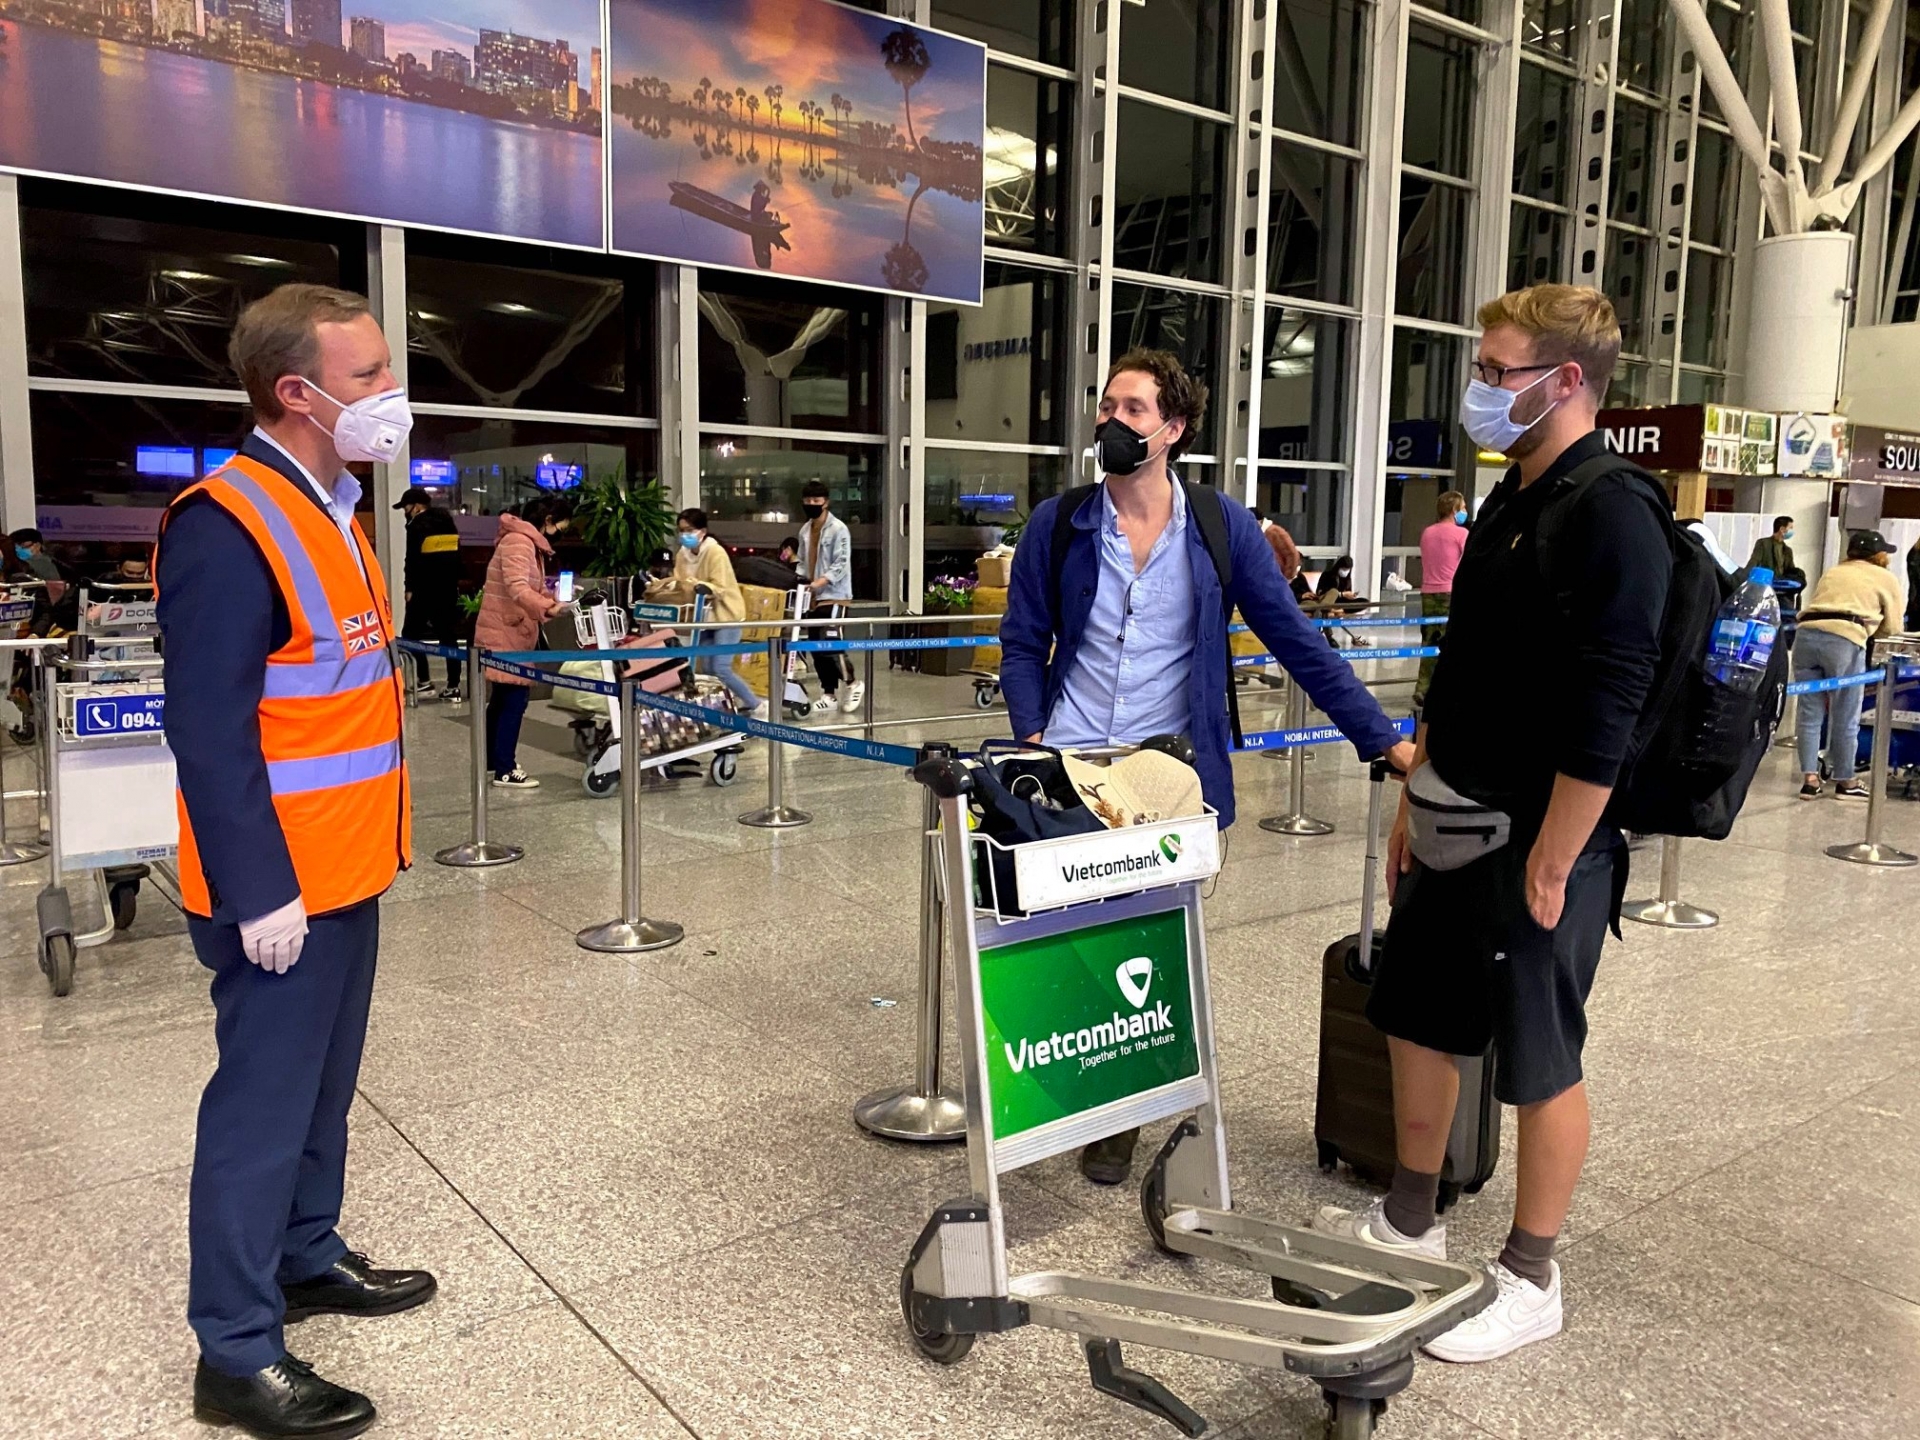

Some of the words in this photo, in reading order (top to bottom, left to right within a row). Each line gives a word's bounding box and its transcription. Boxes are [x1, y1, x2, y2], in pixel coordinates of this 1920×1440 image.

[1886, 445, 1920, 471] SOU
[122, 712, 162, 728] 094.
[1245, 737, 1264, 747] N.I.A
[1062, 850, 1161, 883] Vietcombank
[1004, 1000, 1174, 1073] Vietcombank
[1079, 1050, 1117, 1069] Together
[1120, 1045, 1132, 1056] for
[1135, 1040, 1149, 1052] the
[1151, 1033, 1176, 1047] future
